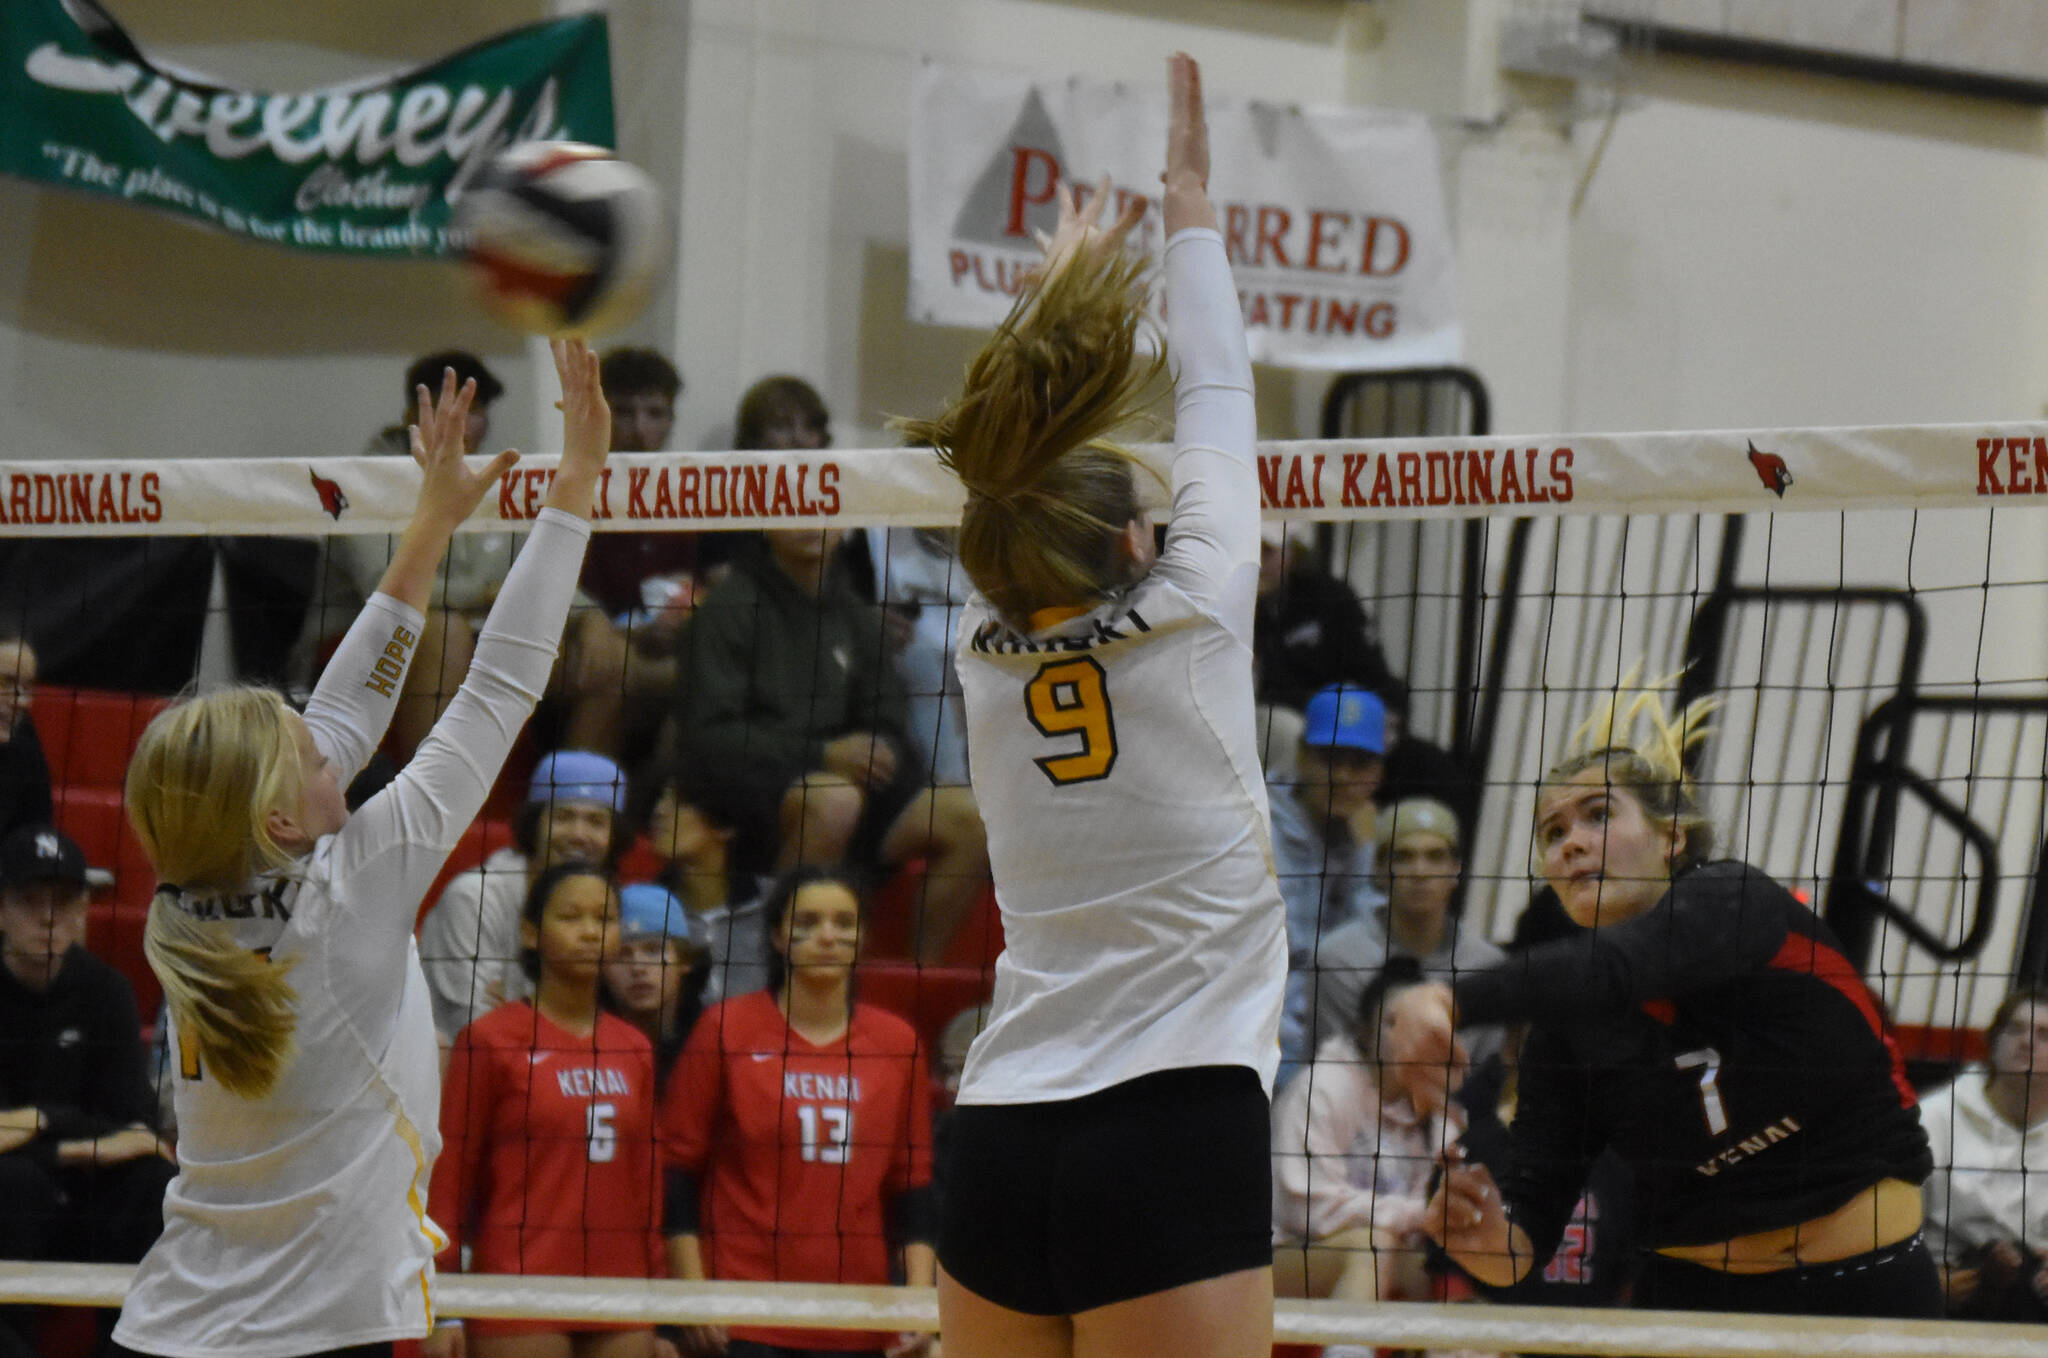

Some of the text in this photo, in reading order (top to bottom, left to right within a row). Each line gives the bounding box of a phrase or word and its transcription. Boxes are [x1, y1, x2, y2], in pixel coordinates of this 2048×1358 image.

[293, 216, 334, 246] the
[339, 219, 431, 248] brands
[1240, 291, 1397, 342] ATING
[499, 461, 841, 520] KEI KARDINALS
[1340, 447, 1575, 508] KARDINALS
[364, 625, 417, 698] HOPE
[1024, 654, 1119, 787] 9
[556, 1067, 632, 1097] KENAI
[784, 1070, 860, 1102] KENAI
[1674, 1047, 1728, 1137] 7
[797, 1105, 853, 1164] 13
